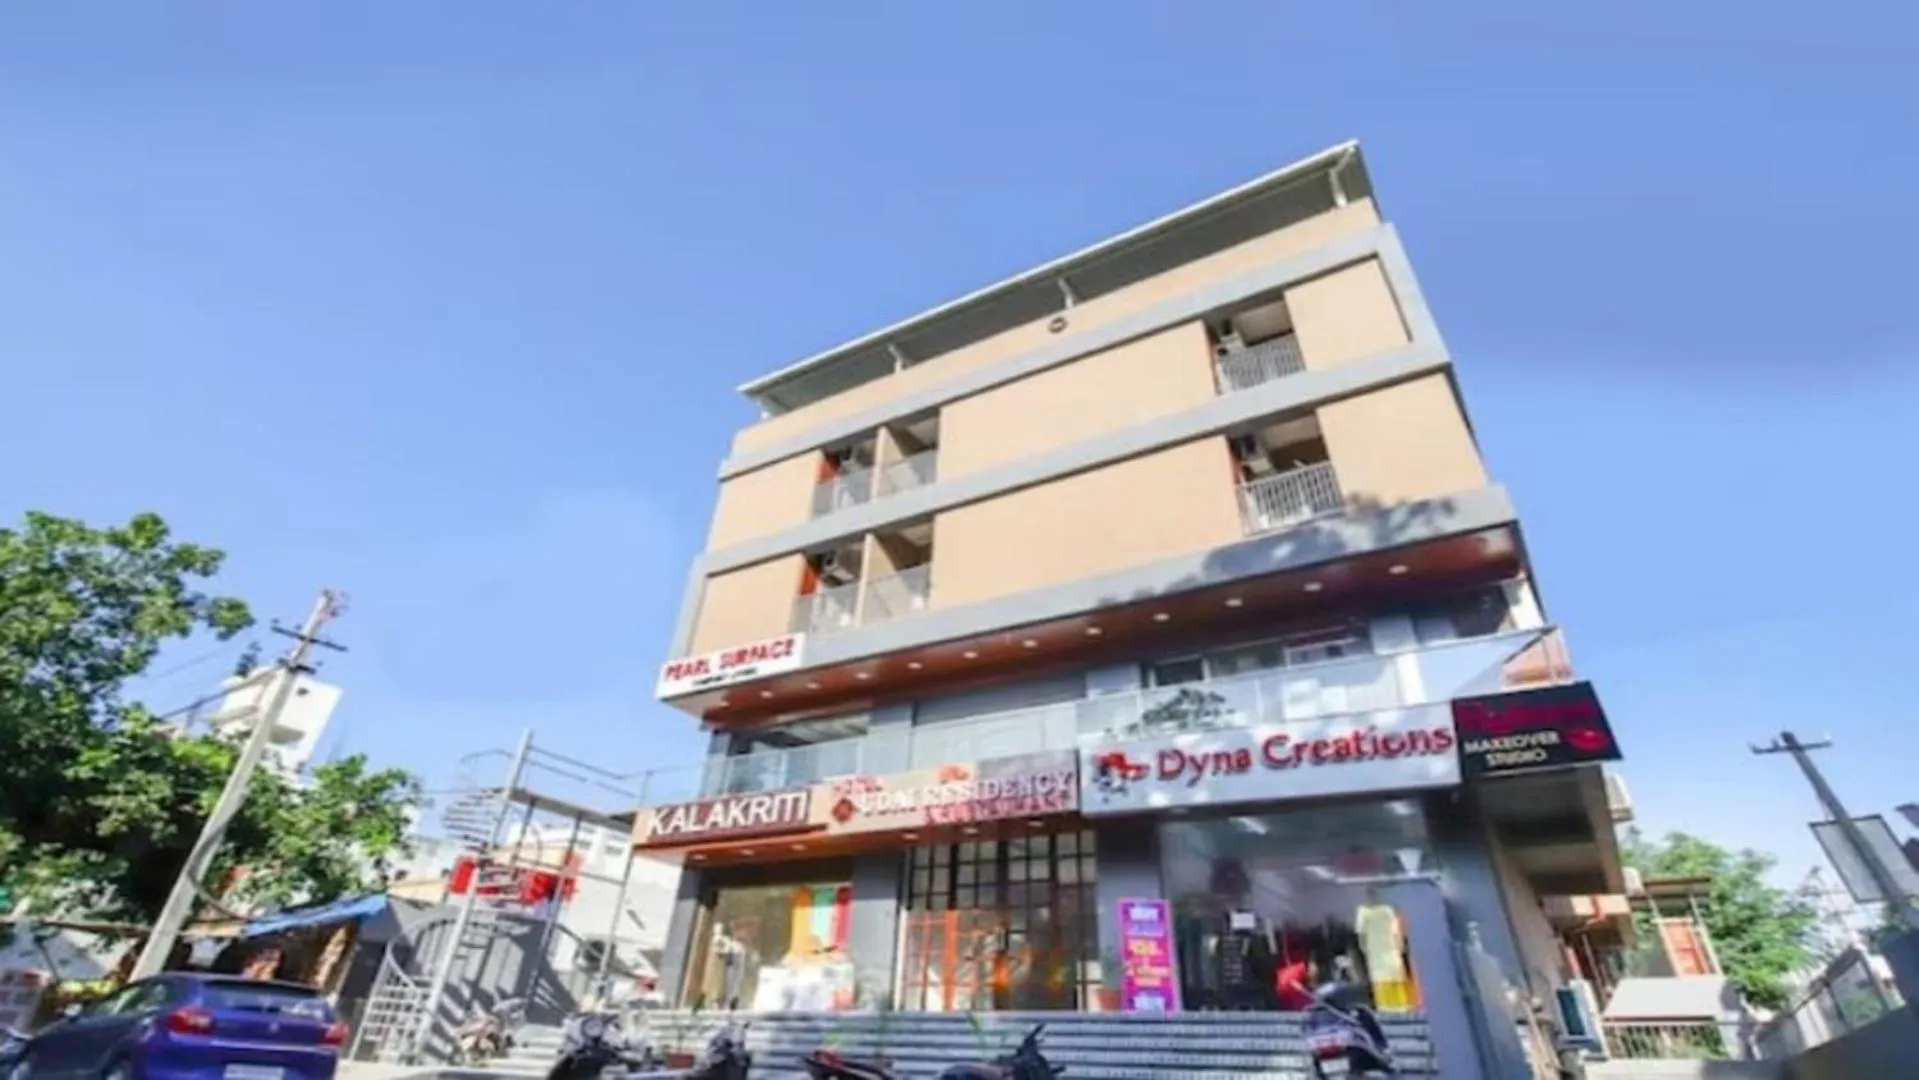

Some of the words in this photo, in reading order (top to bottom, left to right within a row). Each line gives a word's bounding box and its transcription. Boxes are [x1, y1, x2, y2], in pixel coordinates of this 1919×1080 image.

[1156, 748, 1251, 788] Dyna
[1260, 724, 1454, 771] Creations
[1463, 730, 1561, 754] MAKEOVER
[1484, 748, 1547, 768] STUDIO
[646, 791, 807, 836] KALAKRITI
